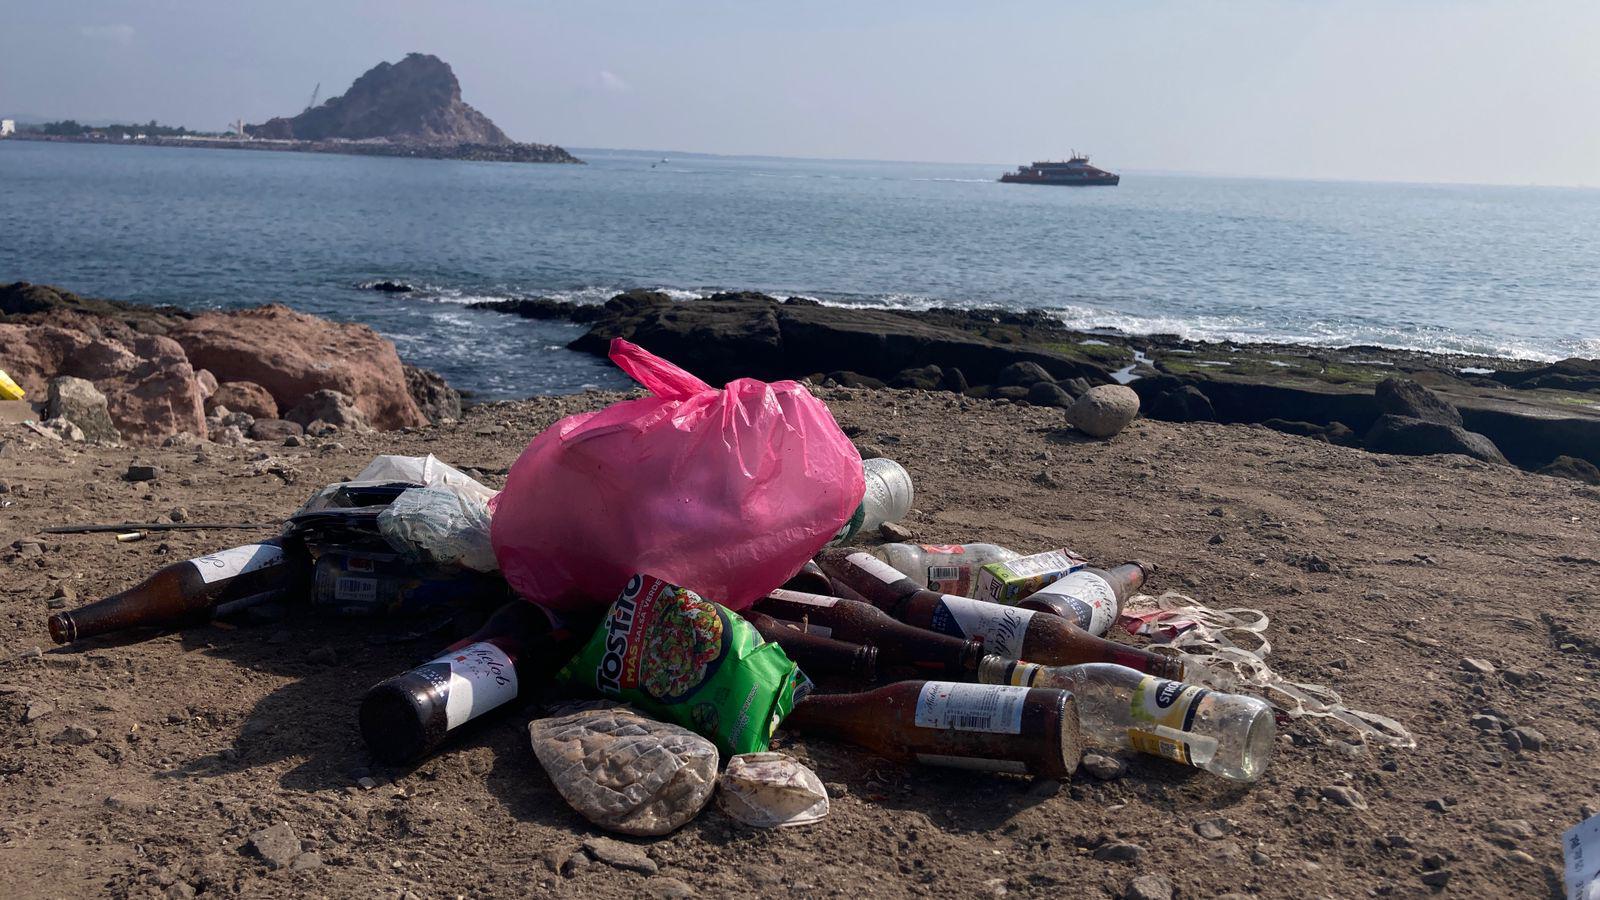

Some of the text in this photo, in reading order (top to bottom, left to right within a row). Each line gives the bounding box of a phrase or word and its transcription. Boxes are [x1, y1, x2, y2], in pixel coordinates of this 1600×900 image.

[596, 572, 643, 691] TOSTITO
[626, 578, 662, 682] MÁS SALSA VERDE
[994, 609, 1021, 656] Mich
